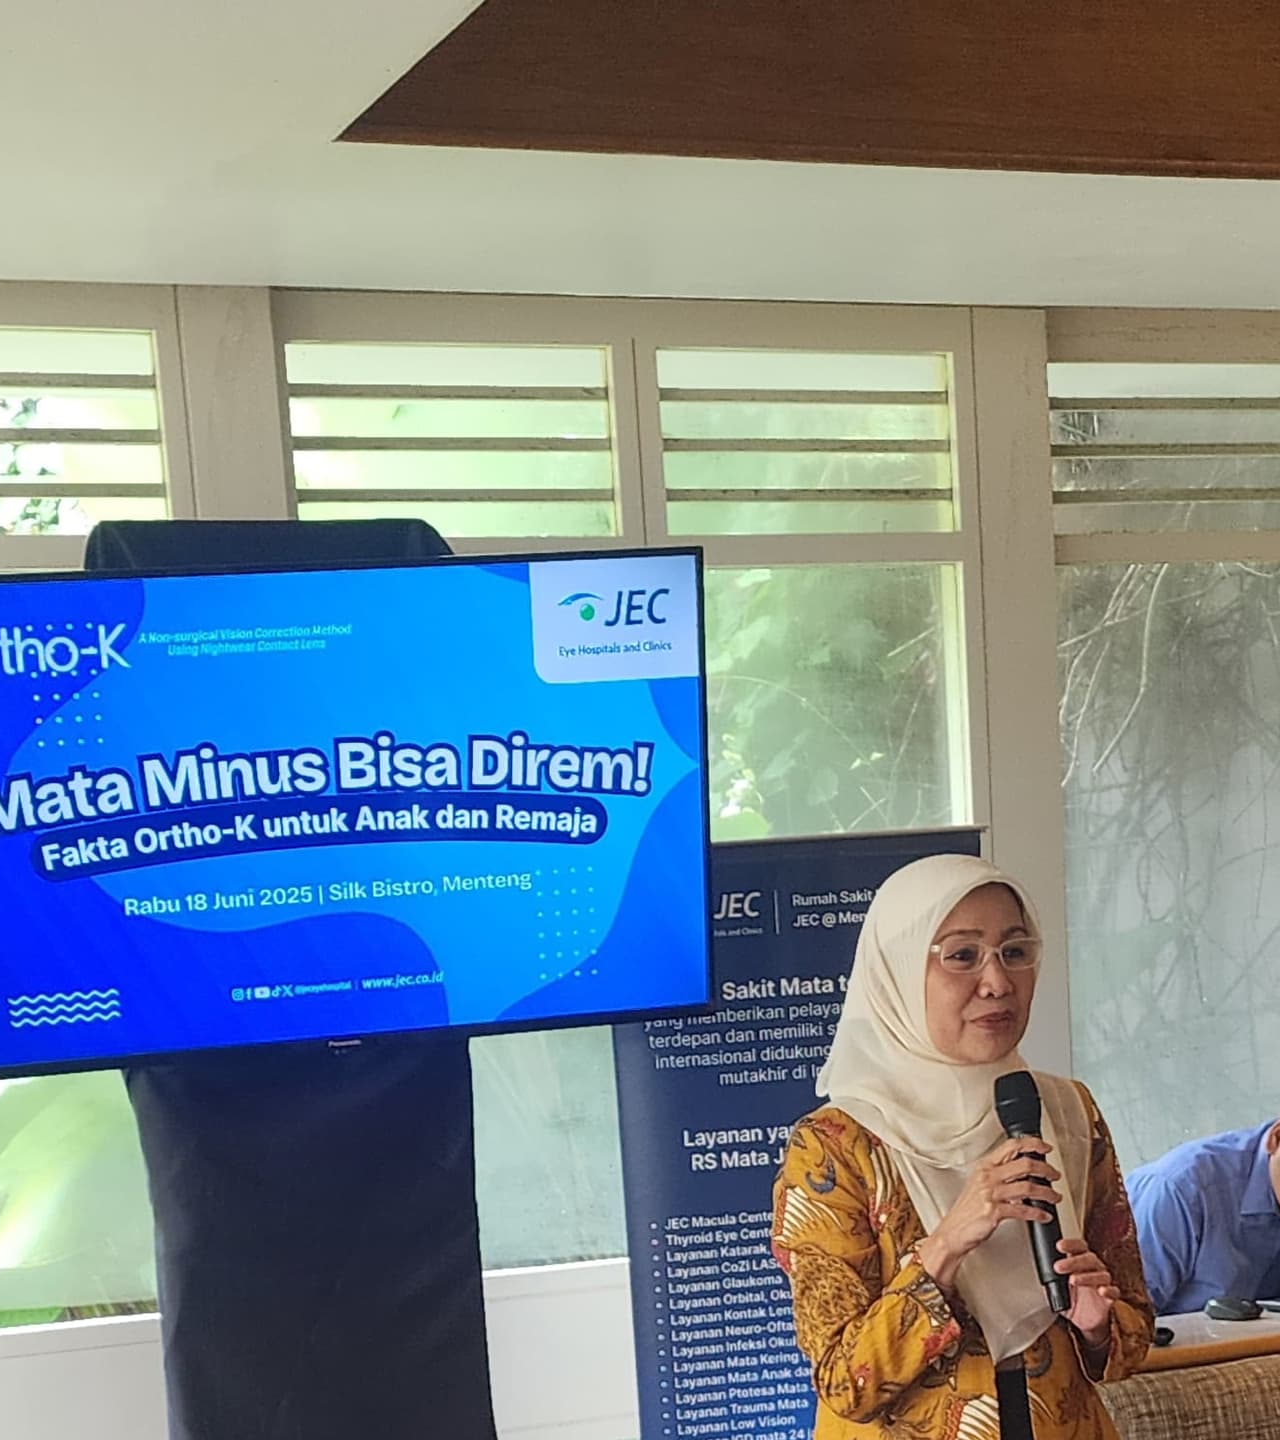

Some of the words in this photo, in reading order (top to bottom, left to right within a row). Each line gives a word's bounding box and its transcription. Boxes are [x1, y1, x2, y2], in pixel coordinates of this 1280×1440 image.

[604, 589, 669, 626] JEC
[139, 634, 146, 643] A
[149, 629, 218, 643] Non-surgical
[221, 628, 252, 640] Vision
[255, 626, 310, 639] Correction
[313, 624, 352, 635] Method
[168, 643, 198, 656] Using
[258, 640, 299, 651] Contact
[559, 646, 575, 657] Eye
[579, 642, 620, 655] Hospitals
[623, 642, 640, 652] and
[643, 640, 672, 651] Clinics
[143, 747, 327, 808] Minus
[337, 735, 457, 789] Bisa
[472, 735, 650, 793] Direm!
[42, 836, 128, 871] Fakta
[135, 814, 258, 853] Ortho-K
[263, 807, 349, 838] untuk
[356, 804, 430, 830] Anak
[436, 804, 488, 829] dan
[496, 805, 597, 837] Remaja
[124, 896, 180, 916] Rabu
[186, 894, 207, 911] 18
[213, 888, 255, 909] Juni
[260, 886, 312, 906] 2025
[329, 881, 367, 901] Silk
[373, 877, 439, 898] Bistro,
[443, 871, 532, 892] Menteng
[792, 893, 838, 906] Rumah
[840, 890, 873, 903] Sakit
[713, 892, 761, 920] JEC
[793, 914, 820, 927] JEC
[822, 913, 836, 927] @
[362, 971, 444, 990] www.jec.co.id
[722, 979, 775, 1000] Sakit
[781, 976, 834, 996] Mata
[789, 1002, 844, 1021] pelaya
[649, 1030, 720, 1049] terdepan
[726, 1029, 754, 1043] dan
[759, 1022, 823, 1041] memiliki
[656, 1050, 756, 1069] internasional
[720, 1067, 787, 1085] mutakhir
[792, 1067, 806, 1079] di
[683, 1126, 762, 1149] Layanan
[692, 1153, 717, 1171] RS
[722, 1151, 768, 1168] Mata
[665, 1218, 689, 1230] JEC
[692, 1214, 736, 1228] Macula
[665, 1233, 713, 1247] Thyroid
[716, 1231, 738, 1242] Eye
[667, 1249, 718, 1264] Layanan
[721, 1244, 770, 1258] Katarak,
[668, 1265, 718, 1280] Layanan
[668, 1280, 719, 1295] Layanan
[723, 1276, 782, 1289] Glaukoma
[670, 1296, 720, 1311] Layanan
[724, 1292, 768, 1304] Orbital,
[671, 1312, 721, 1327] Layanan
[725, 1308, 766, 1320] Kontak
[672, 1328, 722, 1343] Layanan
[672, 1344, 723, 1358] Layanan
[726, 1339, 765, 1352] Infeksi
[674, 1359, 724, 1374] Layanan
[728, 1357, 757, 1368] Mata
[760, 1353, 798, 1365] Kering
[675, 1375, 725, 1390] Layanan
[728, 1372, 758, 1383] Mata
[761, 1369, 791, 1380] Anak
[676, 1391, 726, 1405] Layanan
[777, 1384, 808, 1394] Mata
[677, 1406, 728, 1421] Layanan
[730, 1402, 775, 1414] Trauma
[778, 1399, 808, 1410] Mata
[678, 1422, 728, 1437] Layanan
[731, 1418, 755, 1430] Low
[759, 1415, 795, 1427] Vision
[790, 1428, 803, 1440] 24
